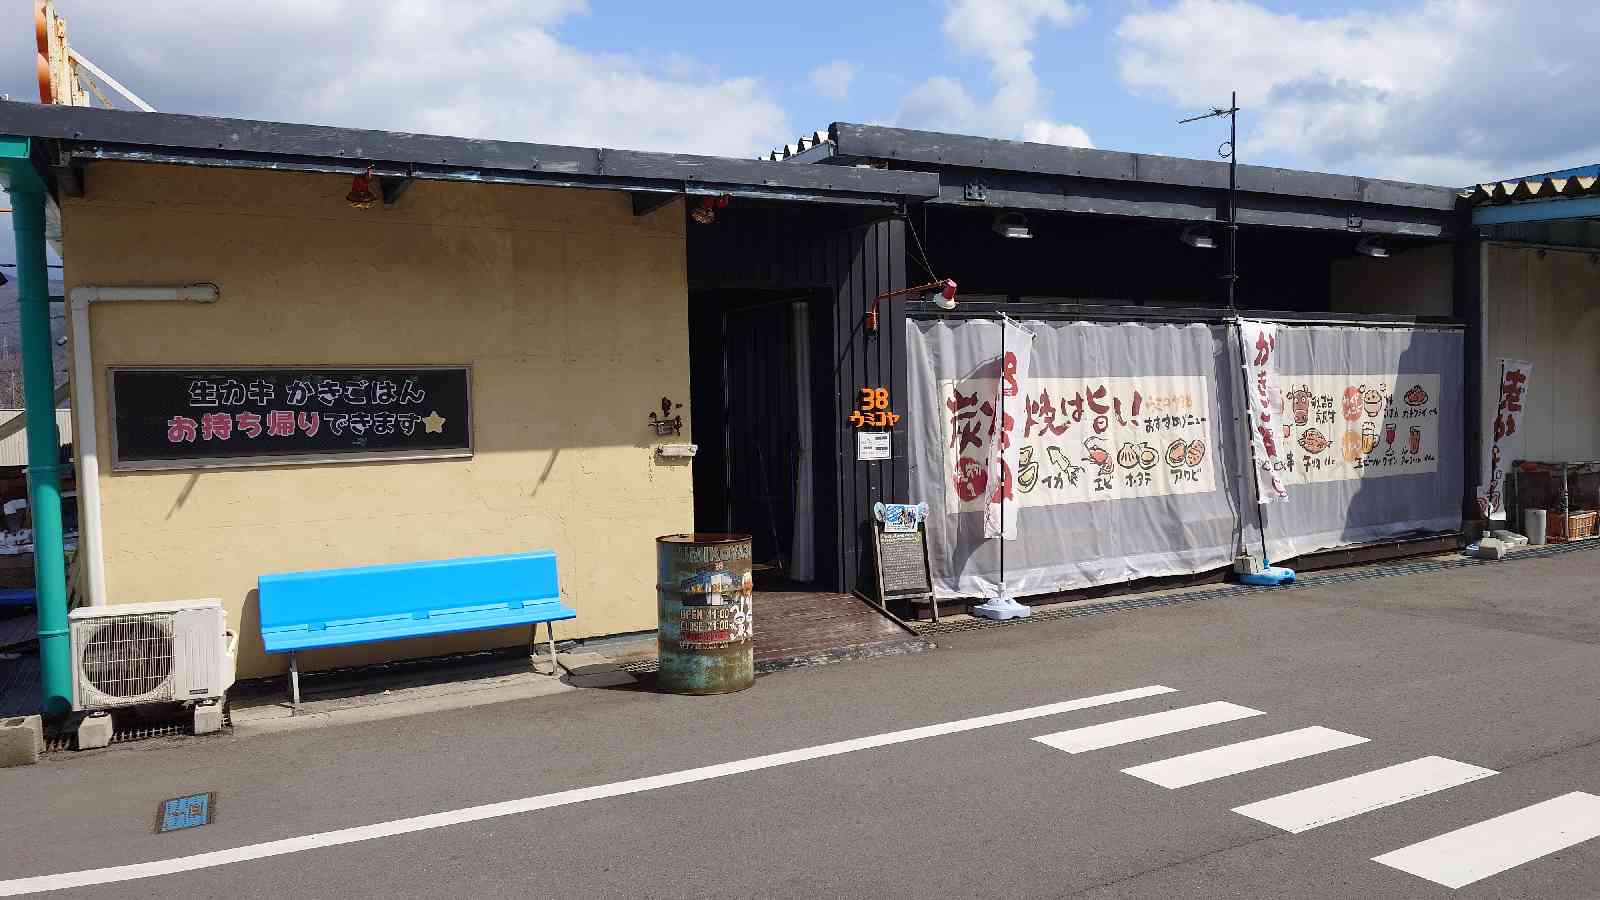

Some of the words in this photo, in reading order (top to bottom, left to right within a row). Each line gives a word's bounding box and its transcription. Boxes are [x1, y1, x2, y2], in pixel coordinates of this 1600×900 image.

[189, 379, 275, 407] 生カキ
[286, 379, 426, 406] かきごはん
[861, 387, 889, 410] 38
[847, 410, 902, 428] ウミコヤ
[1041, 472, 1064, 489] イカ
[1094, 474, 1113, 492] エビ
[1124, 472, 1153, 488] ホタテ
[1170, 468, 1202, 485] アワビ
[680, 609, 704, 620] OPEN
[680, 621, 705, 631] CLOSE
